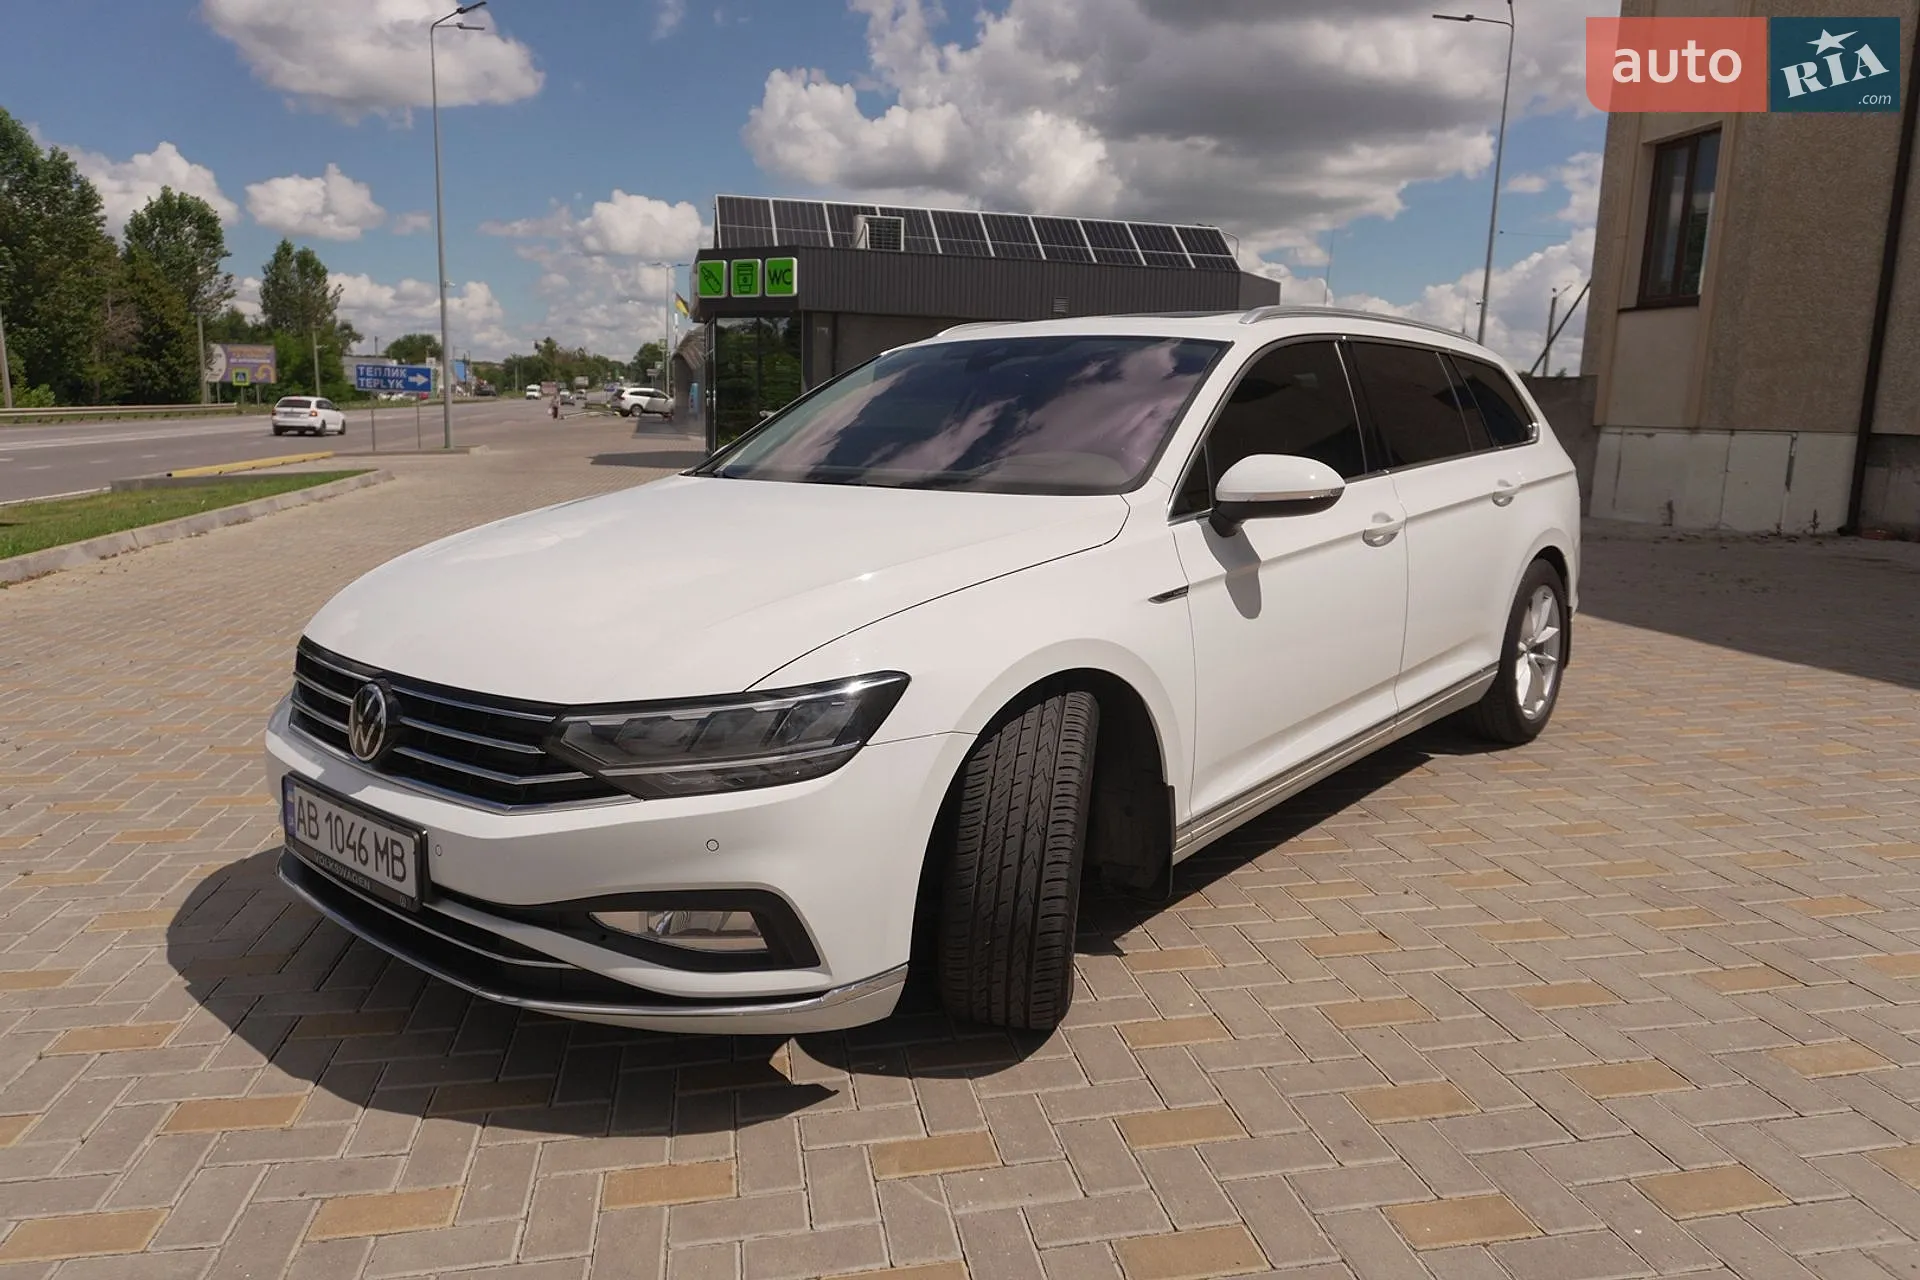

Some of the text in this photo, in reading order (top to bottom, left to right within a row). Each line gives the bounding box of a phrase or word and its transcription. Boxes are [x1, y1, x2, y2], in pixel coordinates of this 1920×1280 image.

[768, 268, 792, 286] WC
[358, 366, 407, 378] ТЕПЛИК
[359, 377, 405, 389] TEPLYK
[297, 795, 407, 883] AB 1046 MB
